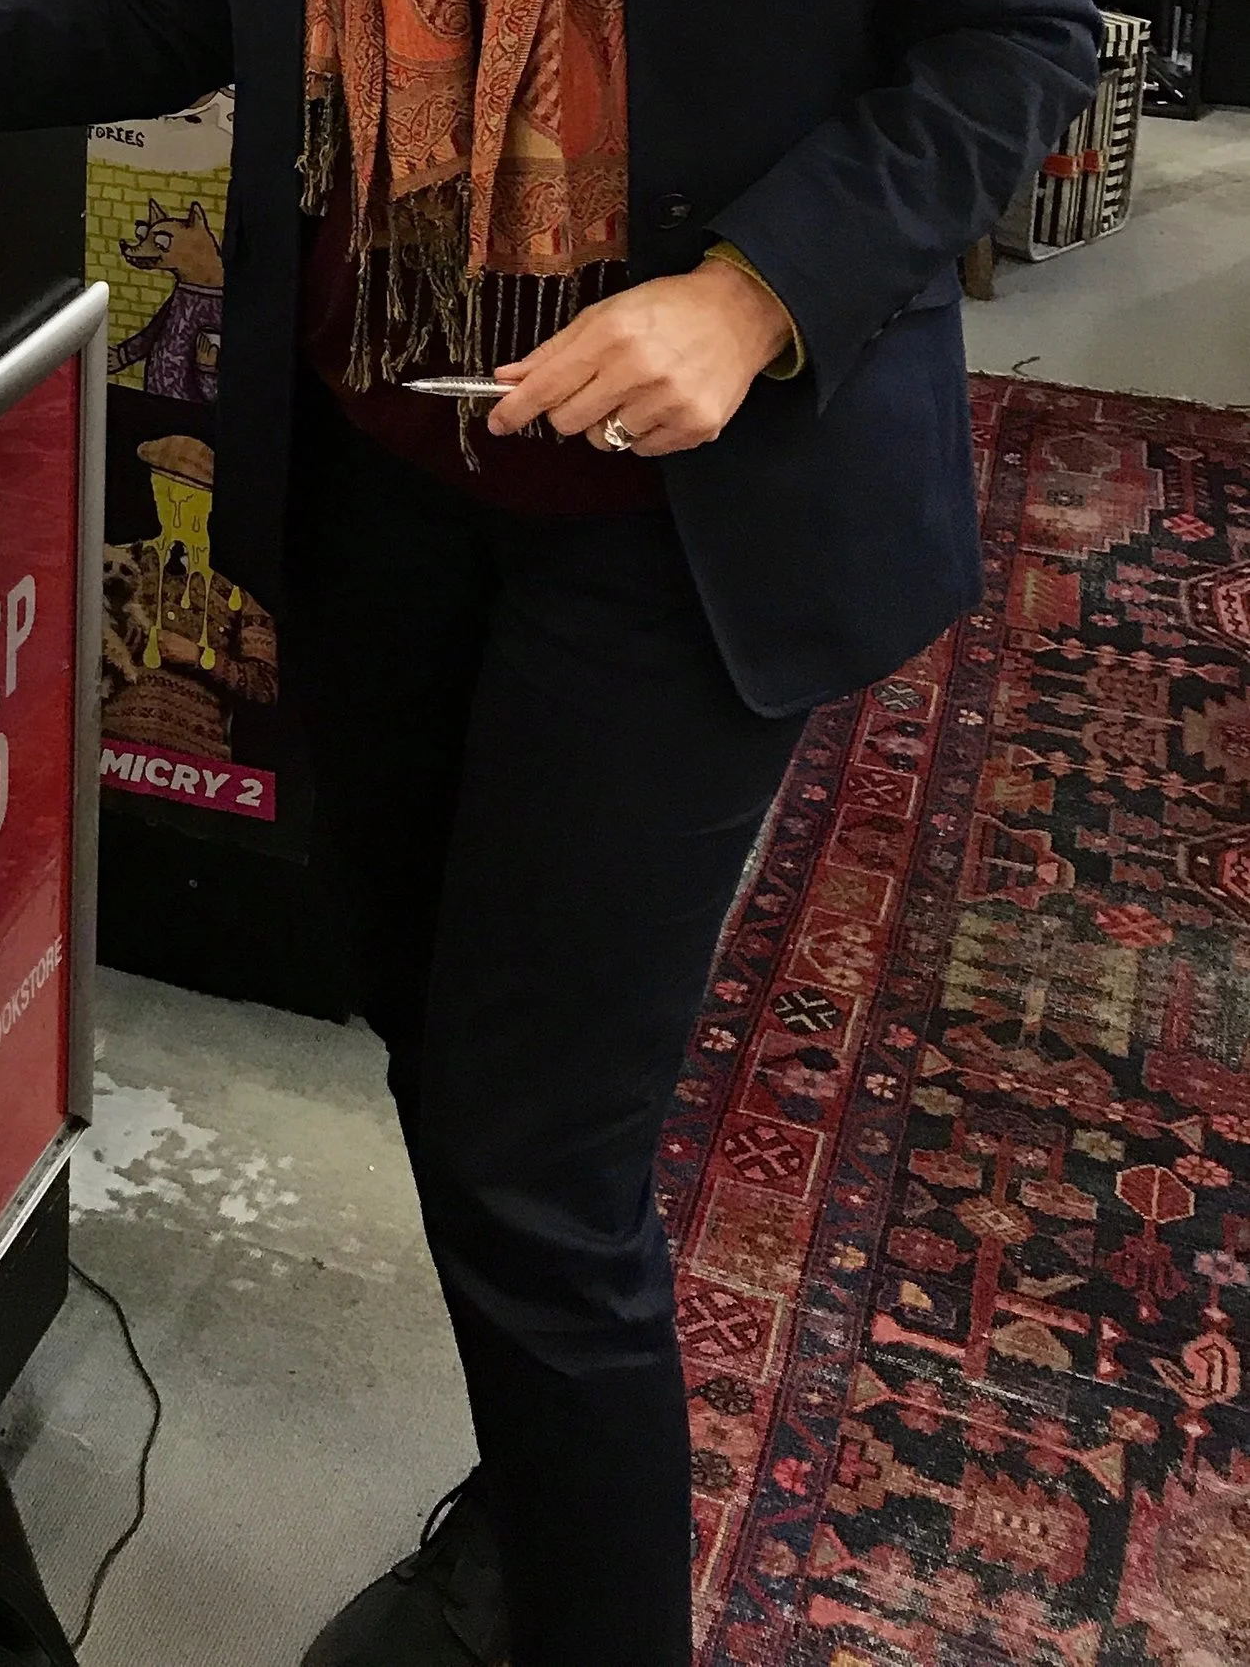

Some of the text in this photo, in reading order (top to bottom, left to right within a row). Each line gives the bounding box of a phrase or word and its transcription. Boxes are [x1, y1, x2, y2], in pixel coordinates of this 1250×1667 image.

[87, 126, 145, 147] TORIES
[100, 748, 263, 807] MICRY 2
